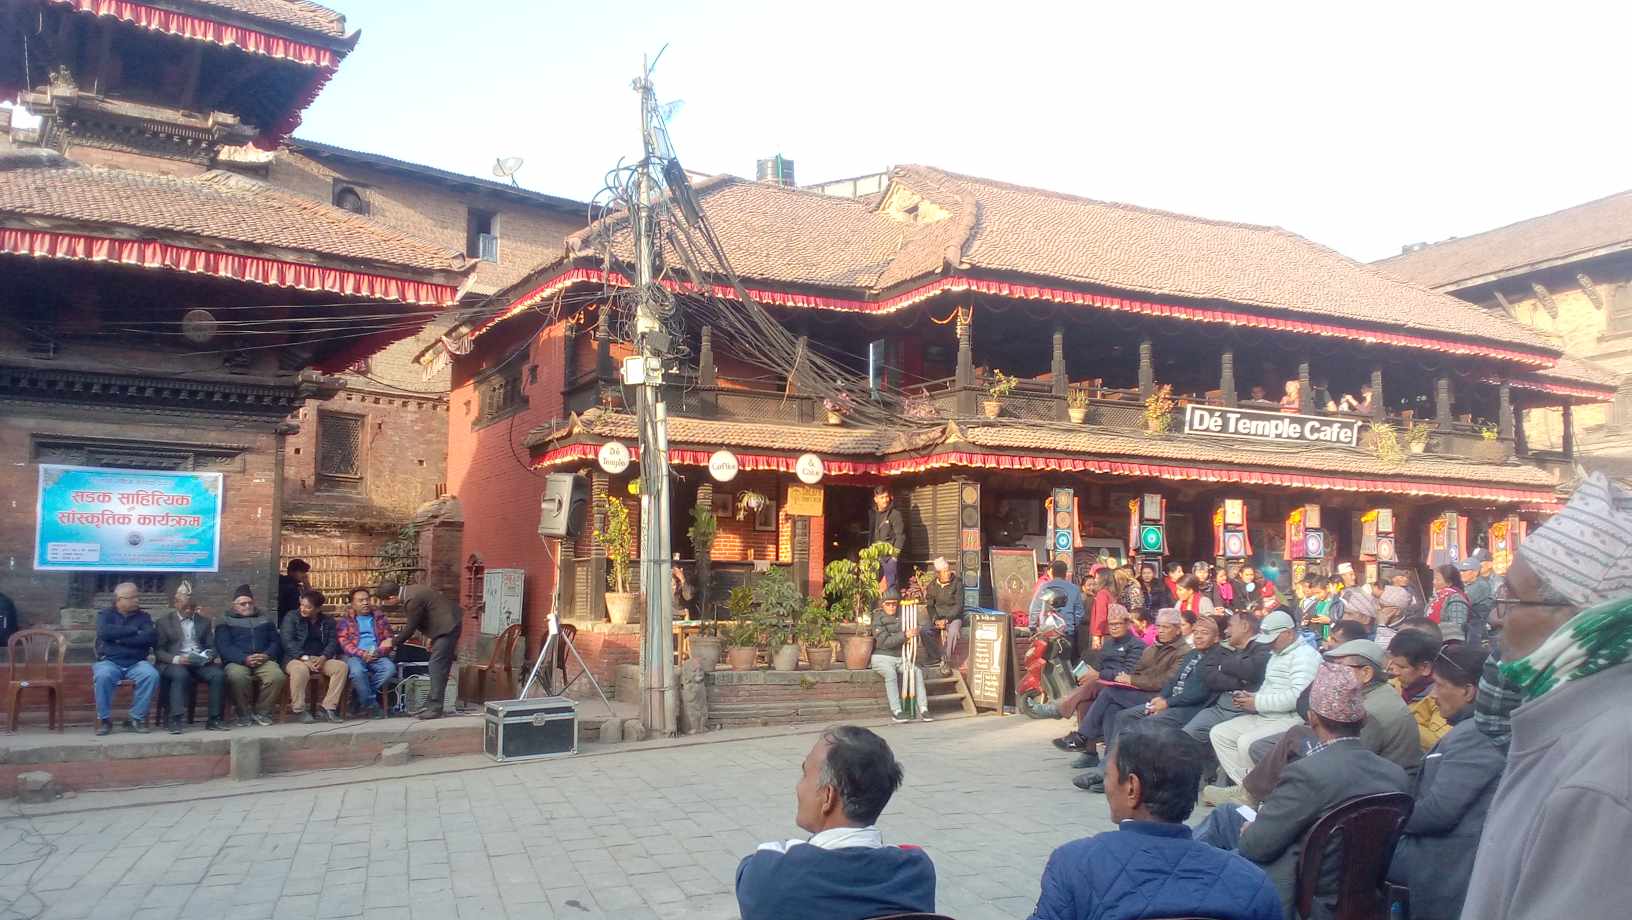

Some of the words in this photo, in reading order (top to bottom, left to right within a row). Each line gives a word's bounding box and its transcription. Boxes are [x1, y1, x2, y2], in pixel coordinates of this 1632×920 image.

[1193, 409, 1222, 431] Dé
[1227, 413, 1301, 439] Temple
[1304, 422, 1352, 442] Cafe
[119, 490, 191, 506] साहित्यिक
[59, 509, 132, 528] सांस्कृतिक
[137, 511, 200, 527] कार्यक्रम
